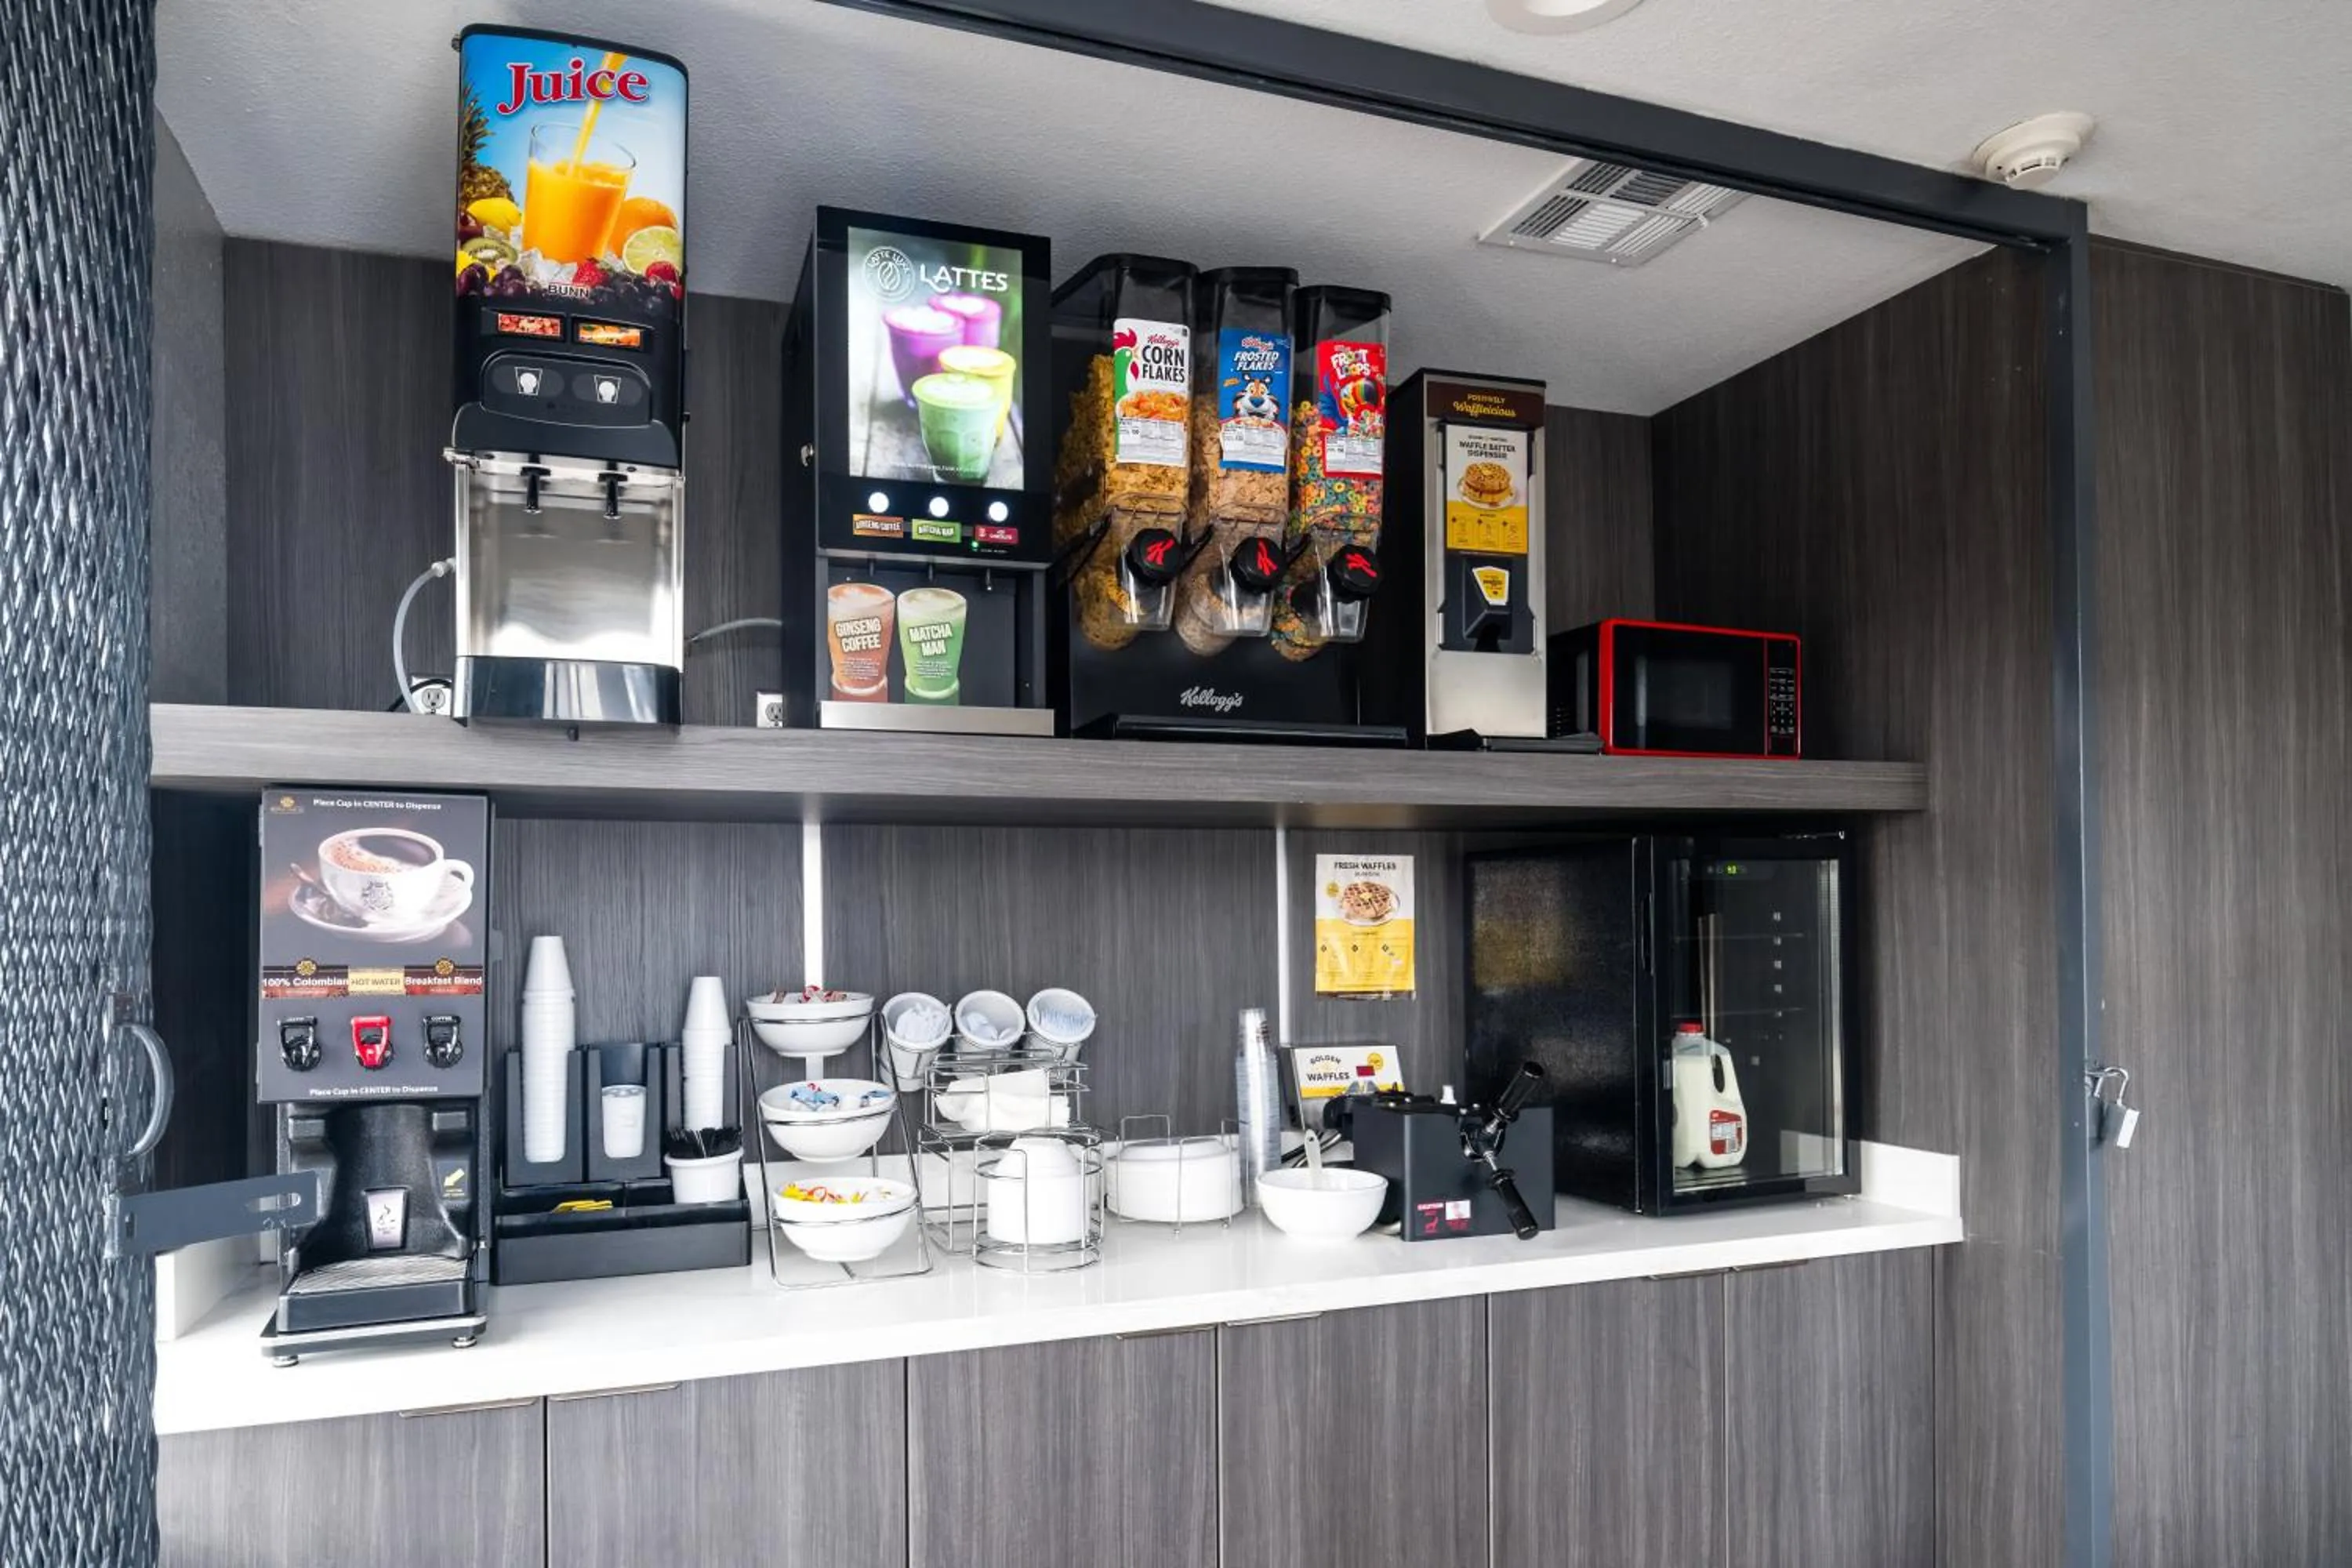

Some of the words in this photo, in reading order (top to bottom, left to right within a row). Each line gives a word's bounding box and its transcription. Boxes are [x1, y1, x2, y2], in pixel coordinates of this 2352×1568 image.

[496, 57, 649, 114] Juice
[920, 263, 1008, 293] LATTES
[549, 285, 589, 298] BUNN
[1142, 345, 1185, 367] CORN
[1233, 350, 1279, 362] FROSTED
[1142, 364, 1185, 383] FLAKES
[1236, 361, 1274, 371] FLAKES
[835, 616, 882, 638] GINSENG
[908, 622, 953, 643] MATCHA
[840, 633, 881, 653] COFFEE
[920, 638, 946, 656] MAN
[1179, 686, 1243, 713] Kellogg's
[314, 798, 335, 807] Place
[336, 799, 353, 809] Cup
[363, 800, 395, 809] CENTER
[292, 977, 349, 987] Colombian
[405, 977, 452, 985] Breakfast
[454, 976, 482, 985] Blend
[1307, 1072, 1350, 1081] WAFFLES
[332, 1087, 349, 1098] Cup
[360, 1086, 391, 1094] CENTER
